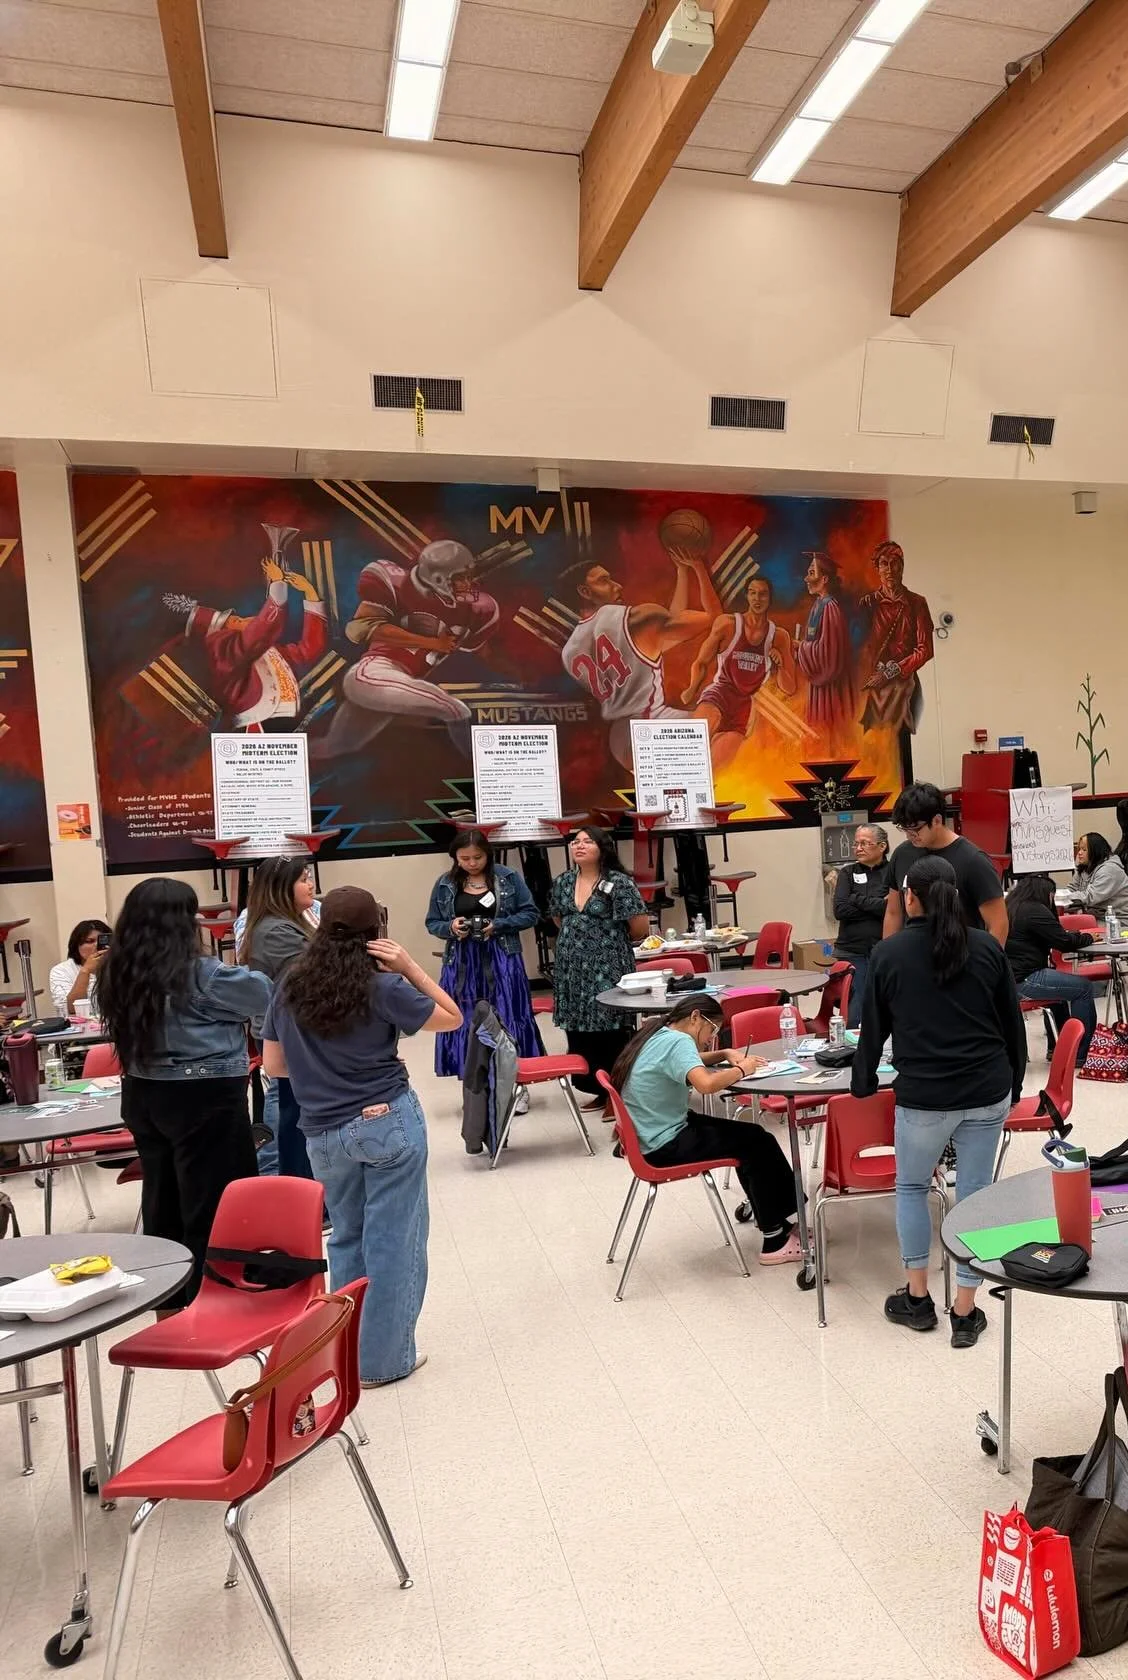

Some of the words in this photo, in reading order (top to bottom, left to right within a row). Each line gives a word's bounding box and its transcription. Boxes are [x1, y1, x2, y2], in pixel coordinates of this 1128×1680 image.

[489, 505, 555, 534] MV
[477, 705, 588, 724] MUSTANGS
[1046, 1583, 1061, 1650] lululemon
